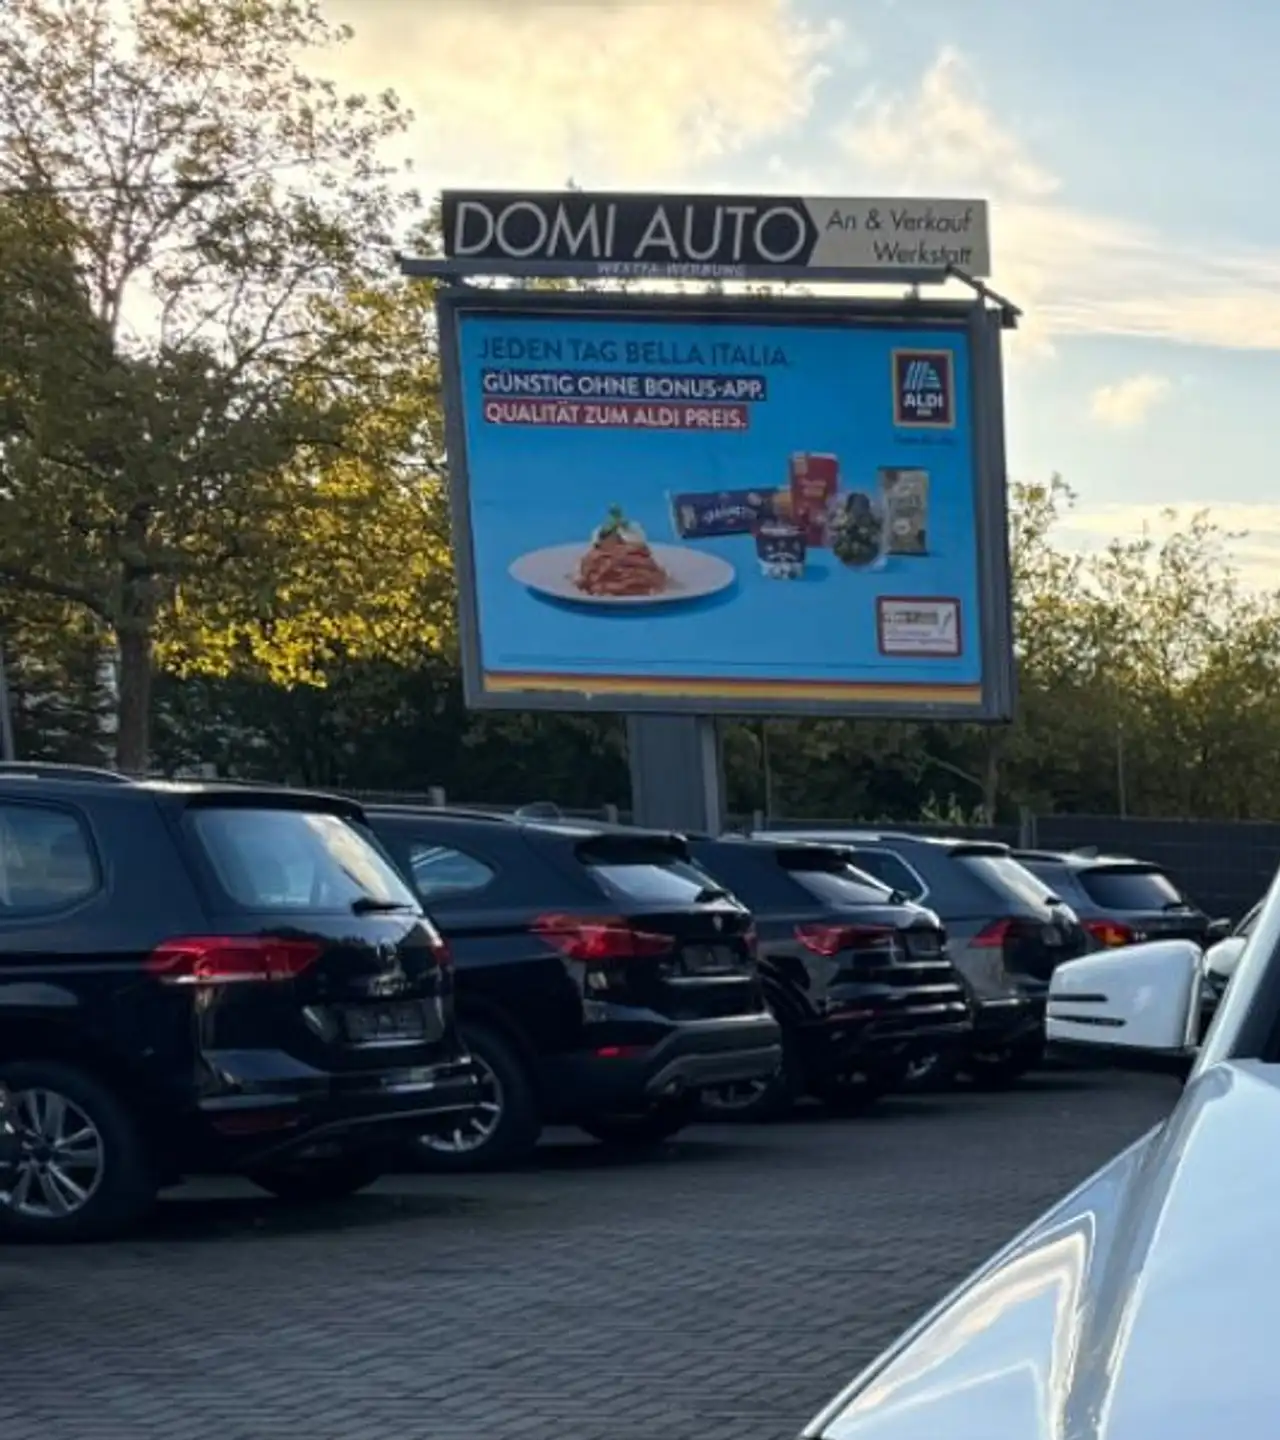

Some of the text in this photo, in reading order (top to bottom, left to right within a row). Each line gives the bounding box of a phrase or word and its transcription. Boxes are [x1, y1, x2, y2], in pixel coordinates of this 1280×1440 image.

[454, 201, 806, 262] DOMI AUTO
[826, 207, 973, 233] An & Verkauf
[873, 239, 973, 265] Werkstatt
[477, 336, 562, 361] JEDEN
[567, 338, 618, 363] TAG
[625, 340, 705, 366] BELLA
[483, 370, 765, 400] GÜNSTIG OHNE BONUS-APP.
[903, 392, 943, 408] ALDI
[486, 400, 748, 430] QUALITÄT ZUM ALDI PREIS.
